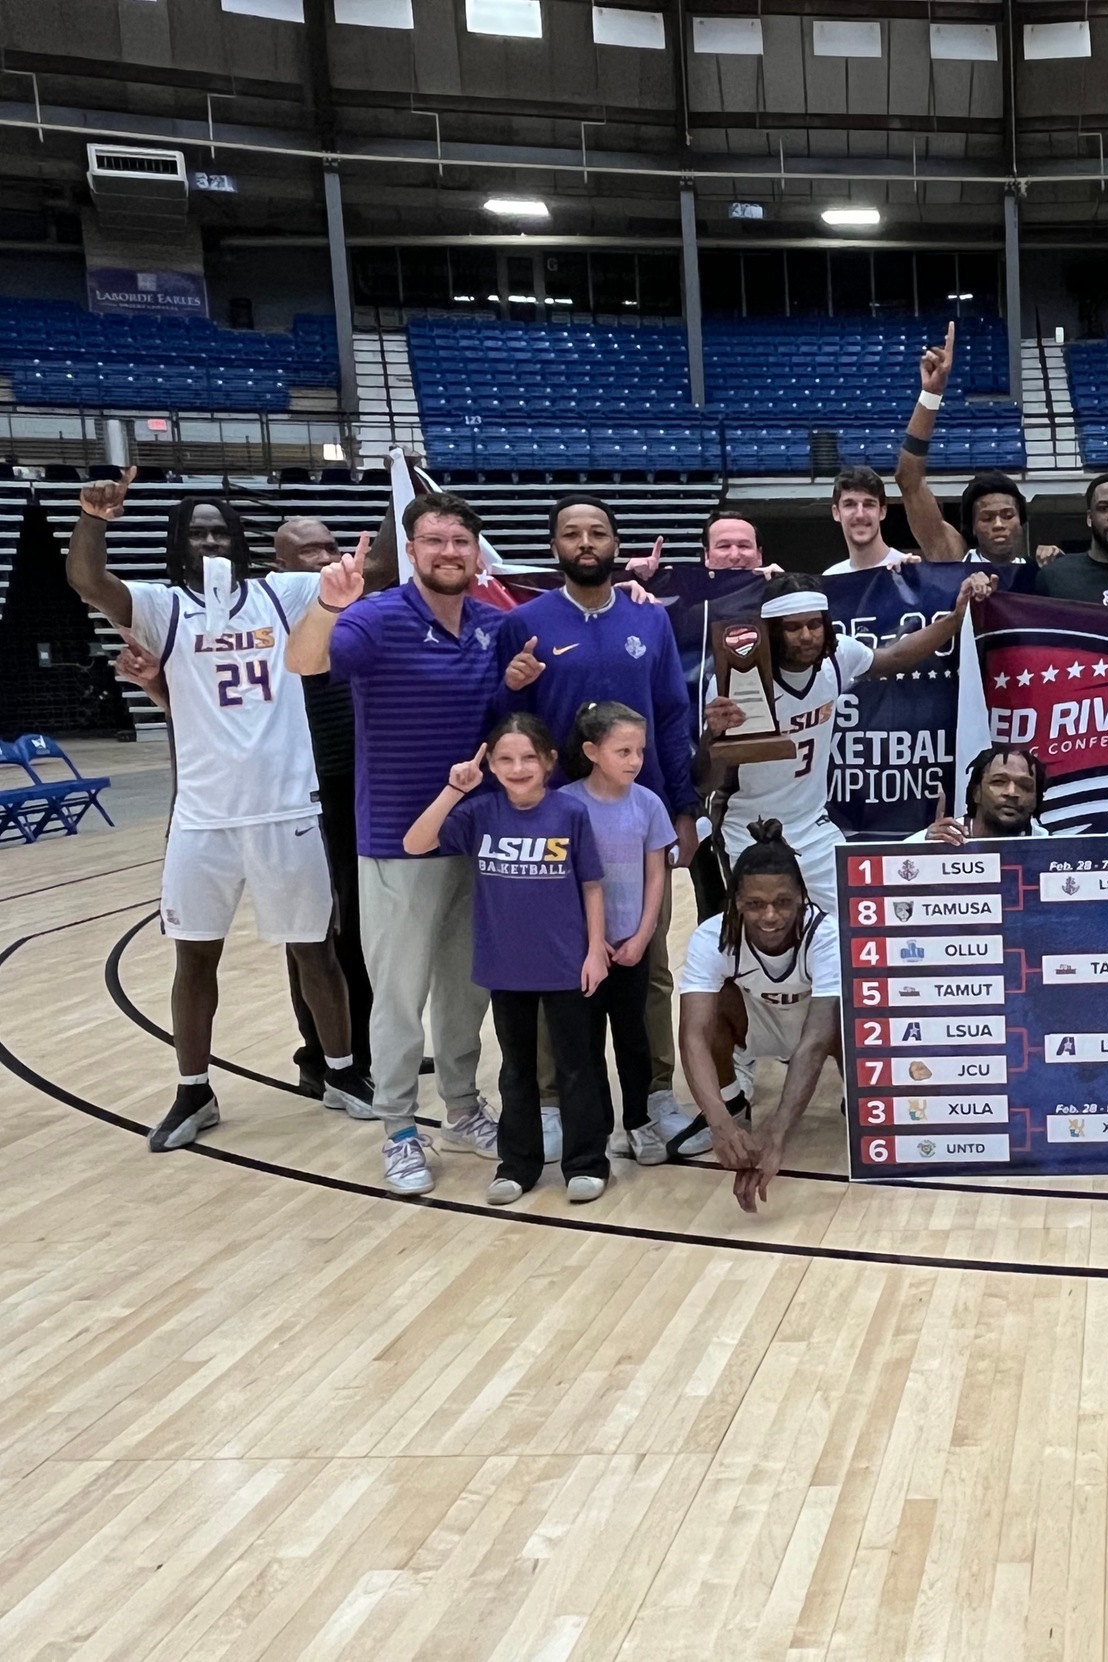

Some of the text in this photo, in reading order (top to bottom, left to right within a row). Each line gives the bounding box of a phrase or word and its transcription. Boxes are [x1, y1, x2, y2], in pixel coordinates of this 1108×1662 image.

[194, 626, 276, 654] LSUS
[215, 659, 274, 709] 24
[794, 738, 815, 779] 3
[478, 834, 570, 862] LSUS
[858, 859, 985, 884] 1 LSUS
[1049, 861, 1073, 871] Feb.
[1076, 860, 1092, 871] 28
[858, 901, 992, 925] 8 TAMUSA
[860, 941, 879, 965] 4
[945, 944, 988, 957] OLLU
[862, 982, 993, 1006] 5 TAMUT
[864, 1022, 882, 1046] 2
[946, 1024, 993, 1039] LSUA
[865, 1062, 990, 1086] 7 JCU
[867, 1100, 993, 1124] 3 XULA
[868, 1140, 985, 1162] 6 UNTD
